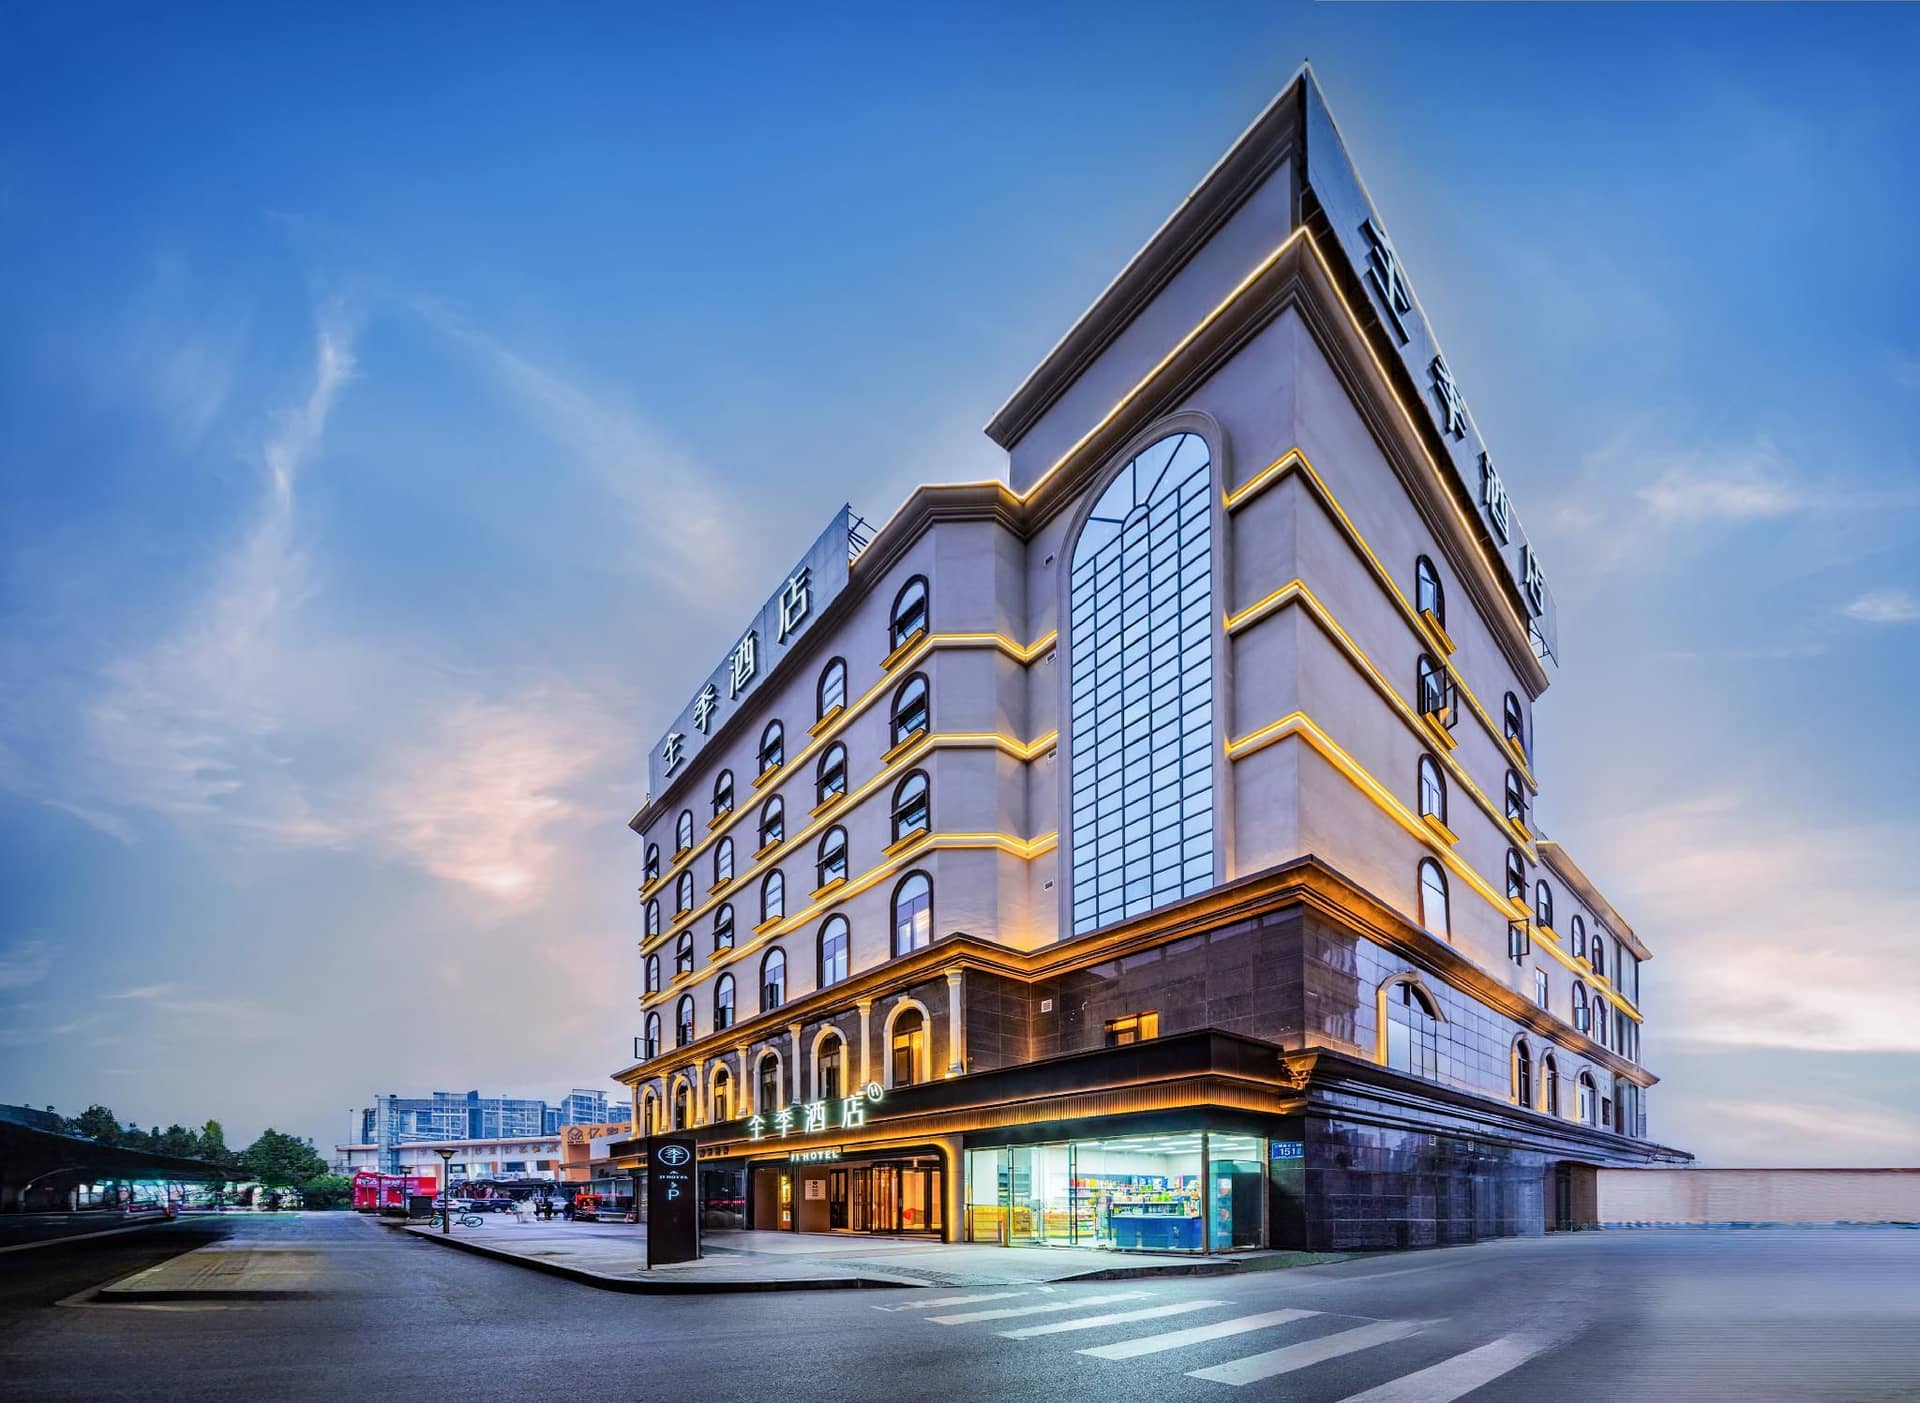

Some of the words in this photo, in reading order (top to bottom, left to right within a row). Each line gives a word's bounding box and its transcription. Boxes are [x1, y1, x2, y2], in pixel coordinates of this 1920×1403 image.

[664, 565, 811, 778] 全季酒店
[749, 1094, 865, 1141] 全季酒店
[803, 1150, 839, 1162] HOTEL
[668, 1189, 680, 1201] P
